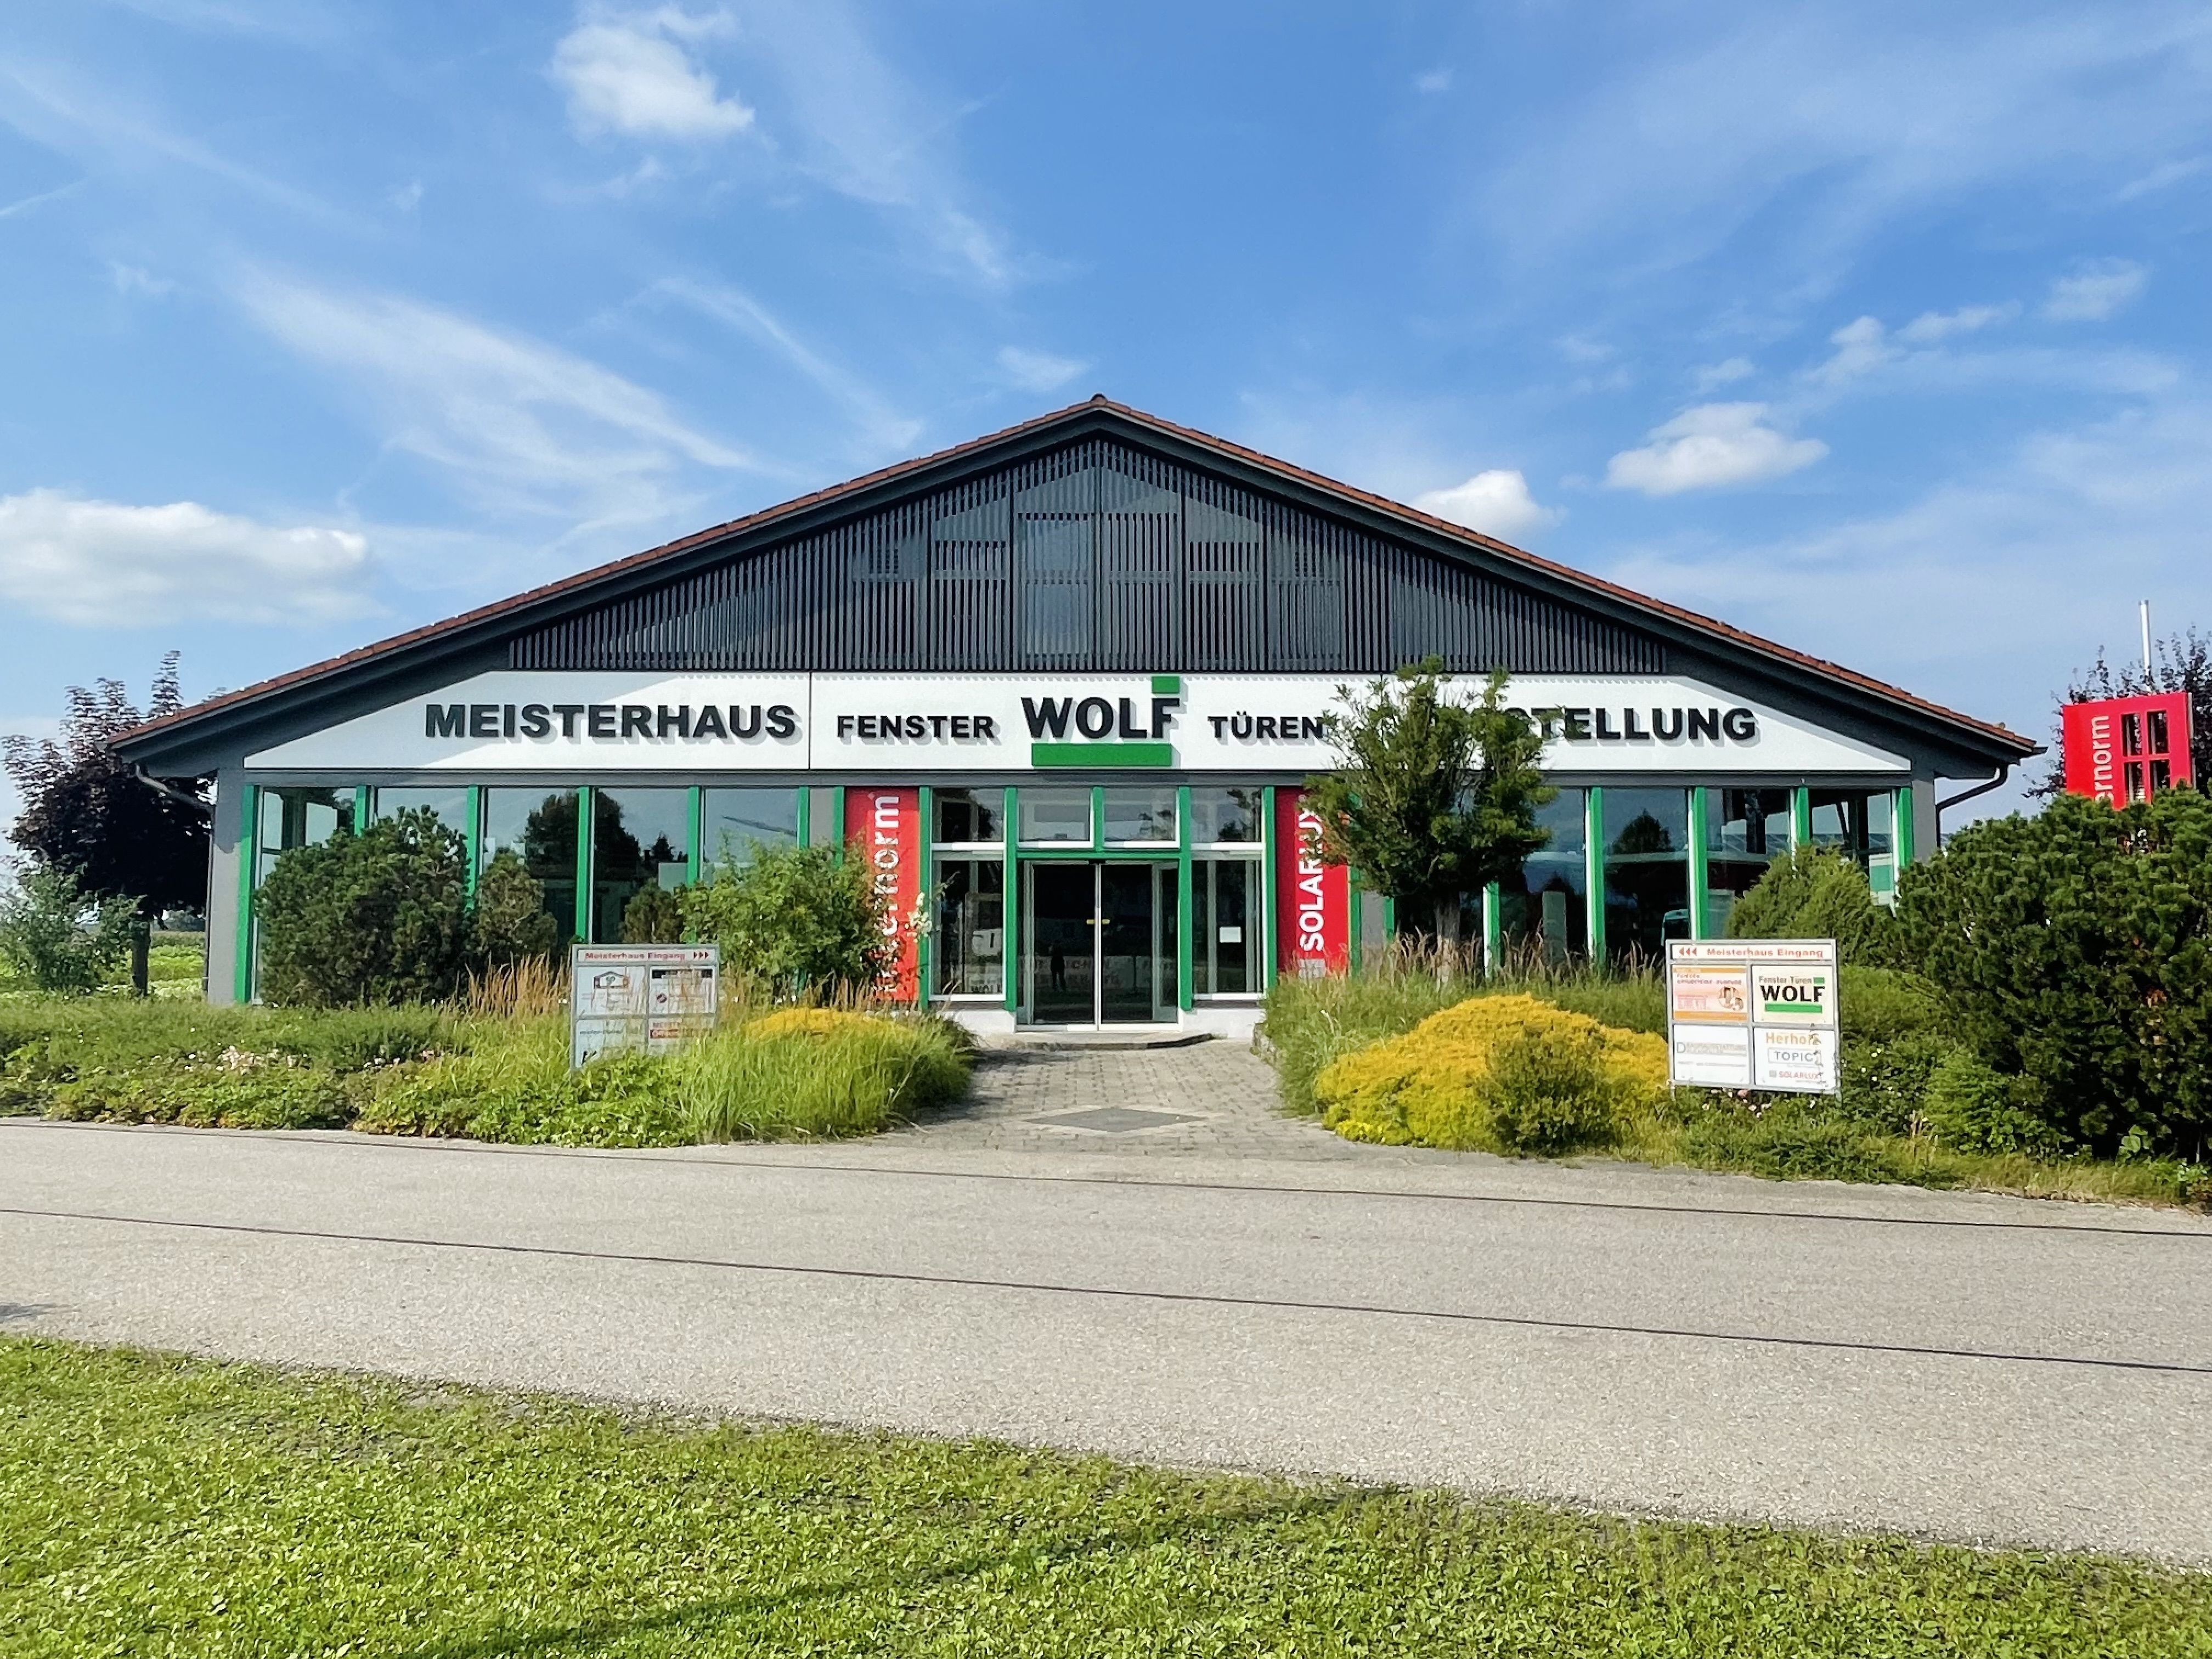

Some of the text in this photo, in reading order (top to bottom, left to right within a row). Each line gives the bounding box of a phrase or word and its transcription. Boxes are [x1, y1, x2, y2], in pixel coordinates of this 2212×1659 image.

[425, 697, 1756, 740] MEISTERHAUS FENSTER WOLF TÜREN TELLUNG
[2091, 715, 2114, 803] rnorm
[1707, 948, 1824, 958] Meisterhaus Eingang
[1760, 985, 1826, 1003] WOLF
[1765, 1032, 1819, 1046] Herhol
[1774, 1050, 1814, 1062] TOPIC
